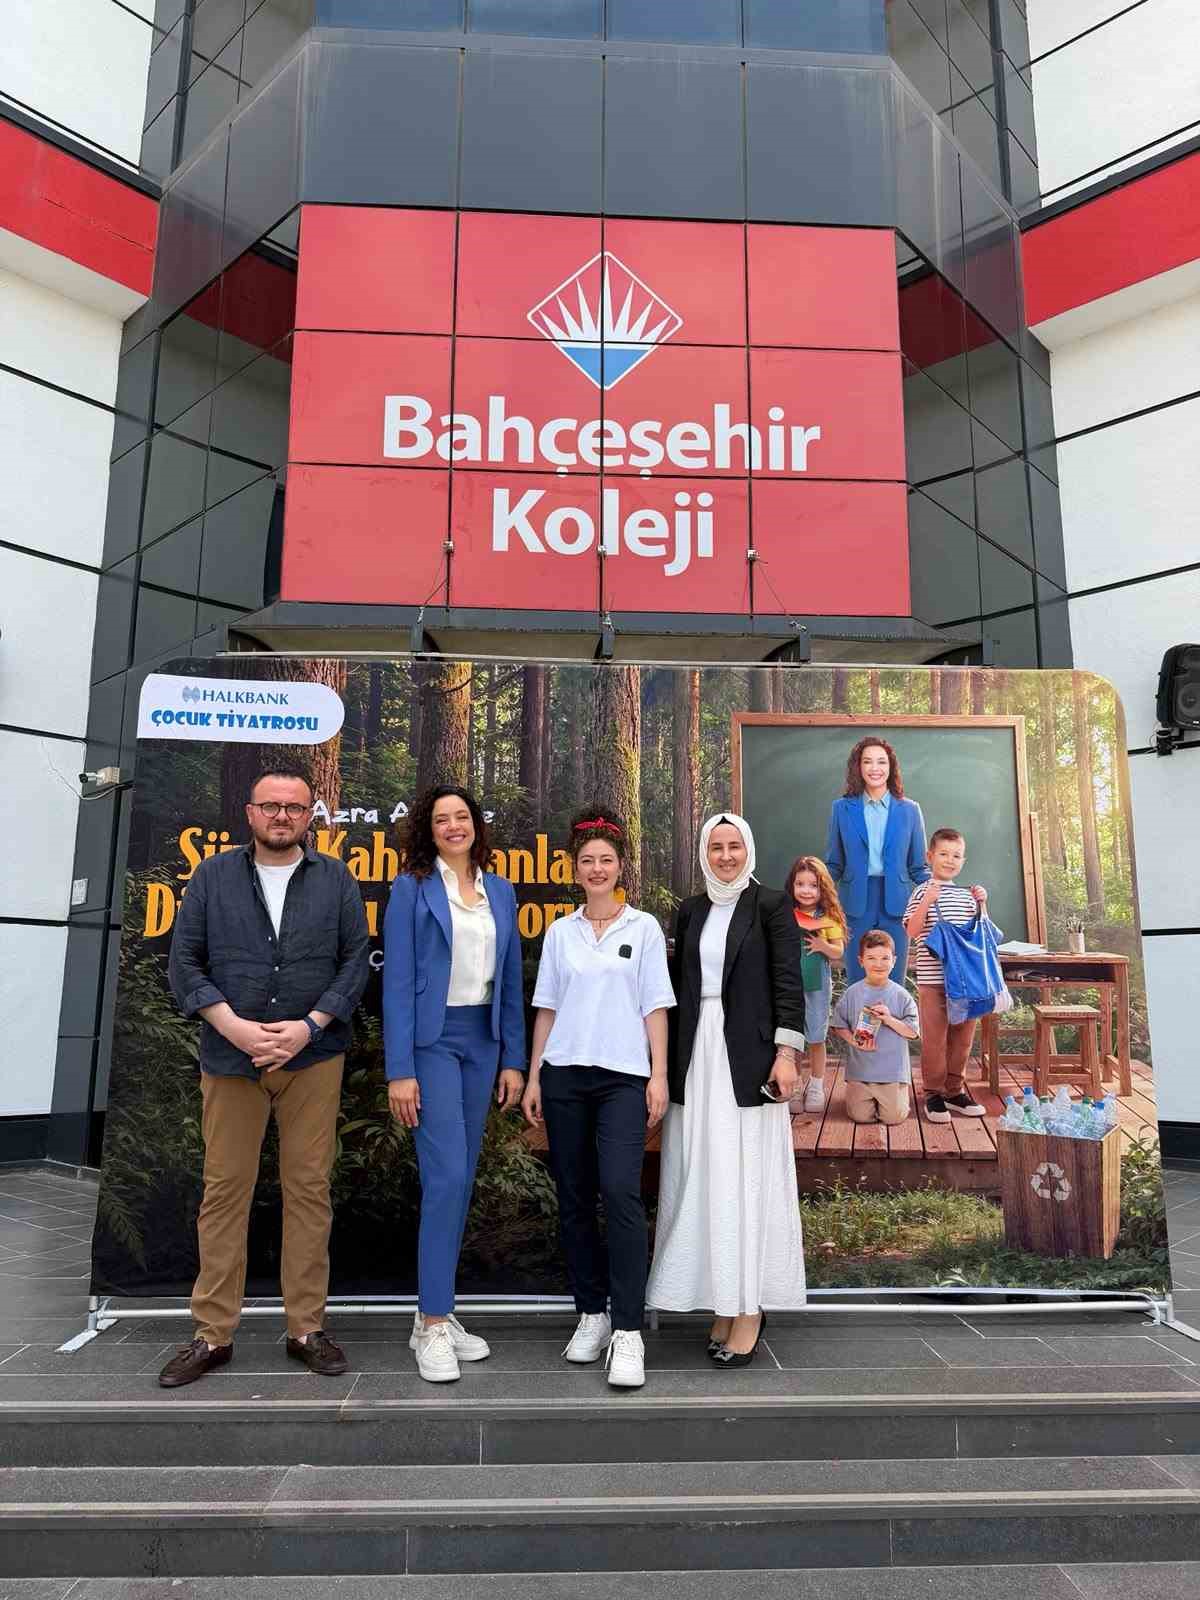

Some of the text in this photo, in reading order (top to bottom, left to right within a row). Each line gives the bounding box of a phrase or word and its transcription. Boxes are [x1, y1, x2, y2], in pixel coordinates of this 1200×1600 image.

[382, 395, 821, 480] Bahçeşehir
[492, 488, 714, 576] Koleji
[202, 690, 289, 705] HALKBANK
[151, 709, 319, 731] ÇOCUK TİYATROSU
[310, 799, 379, 825] Azra
